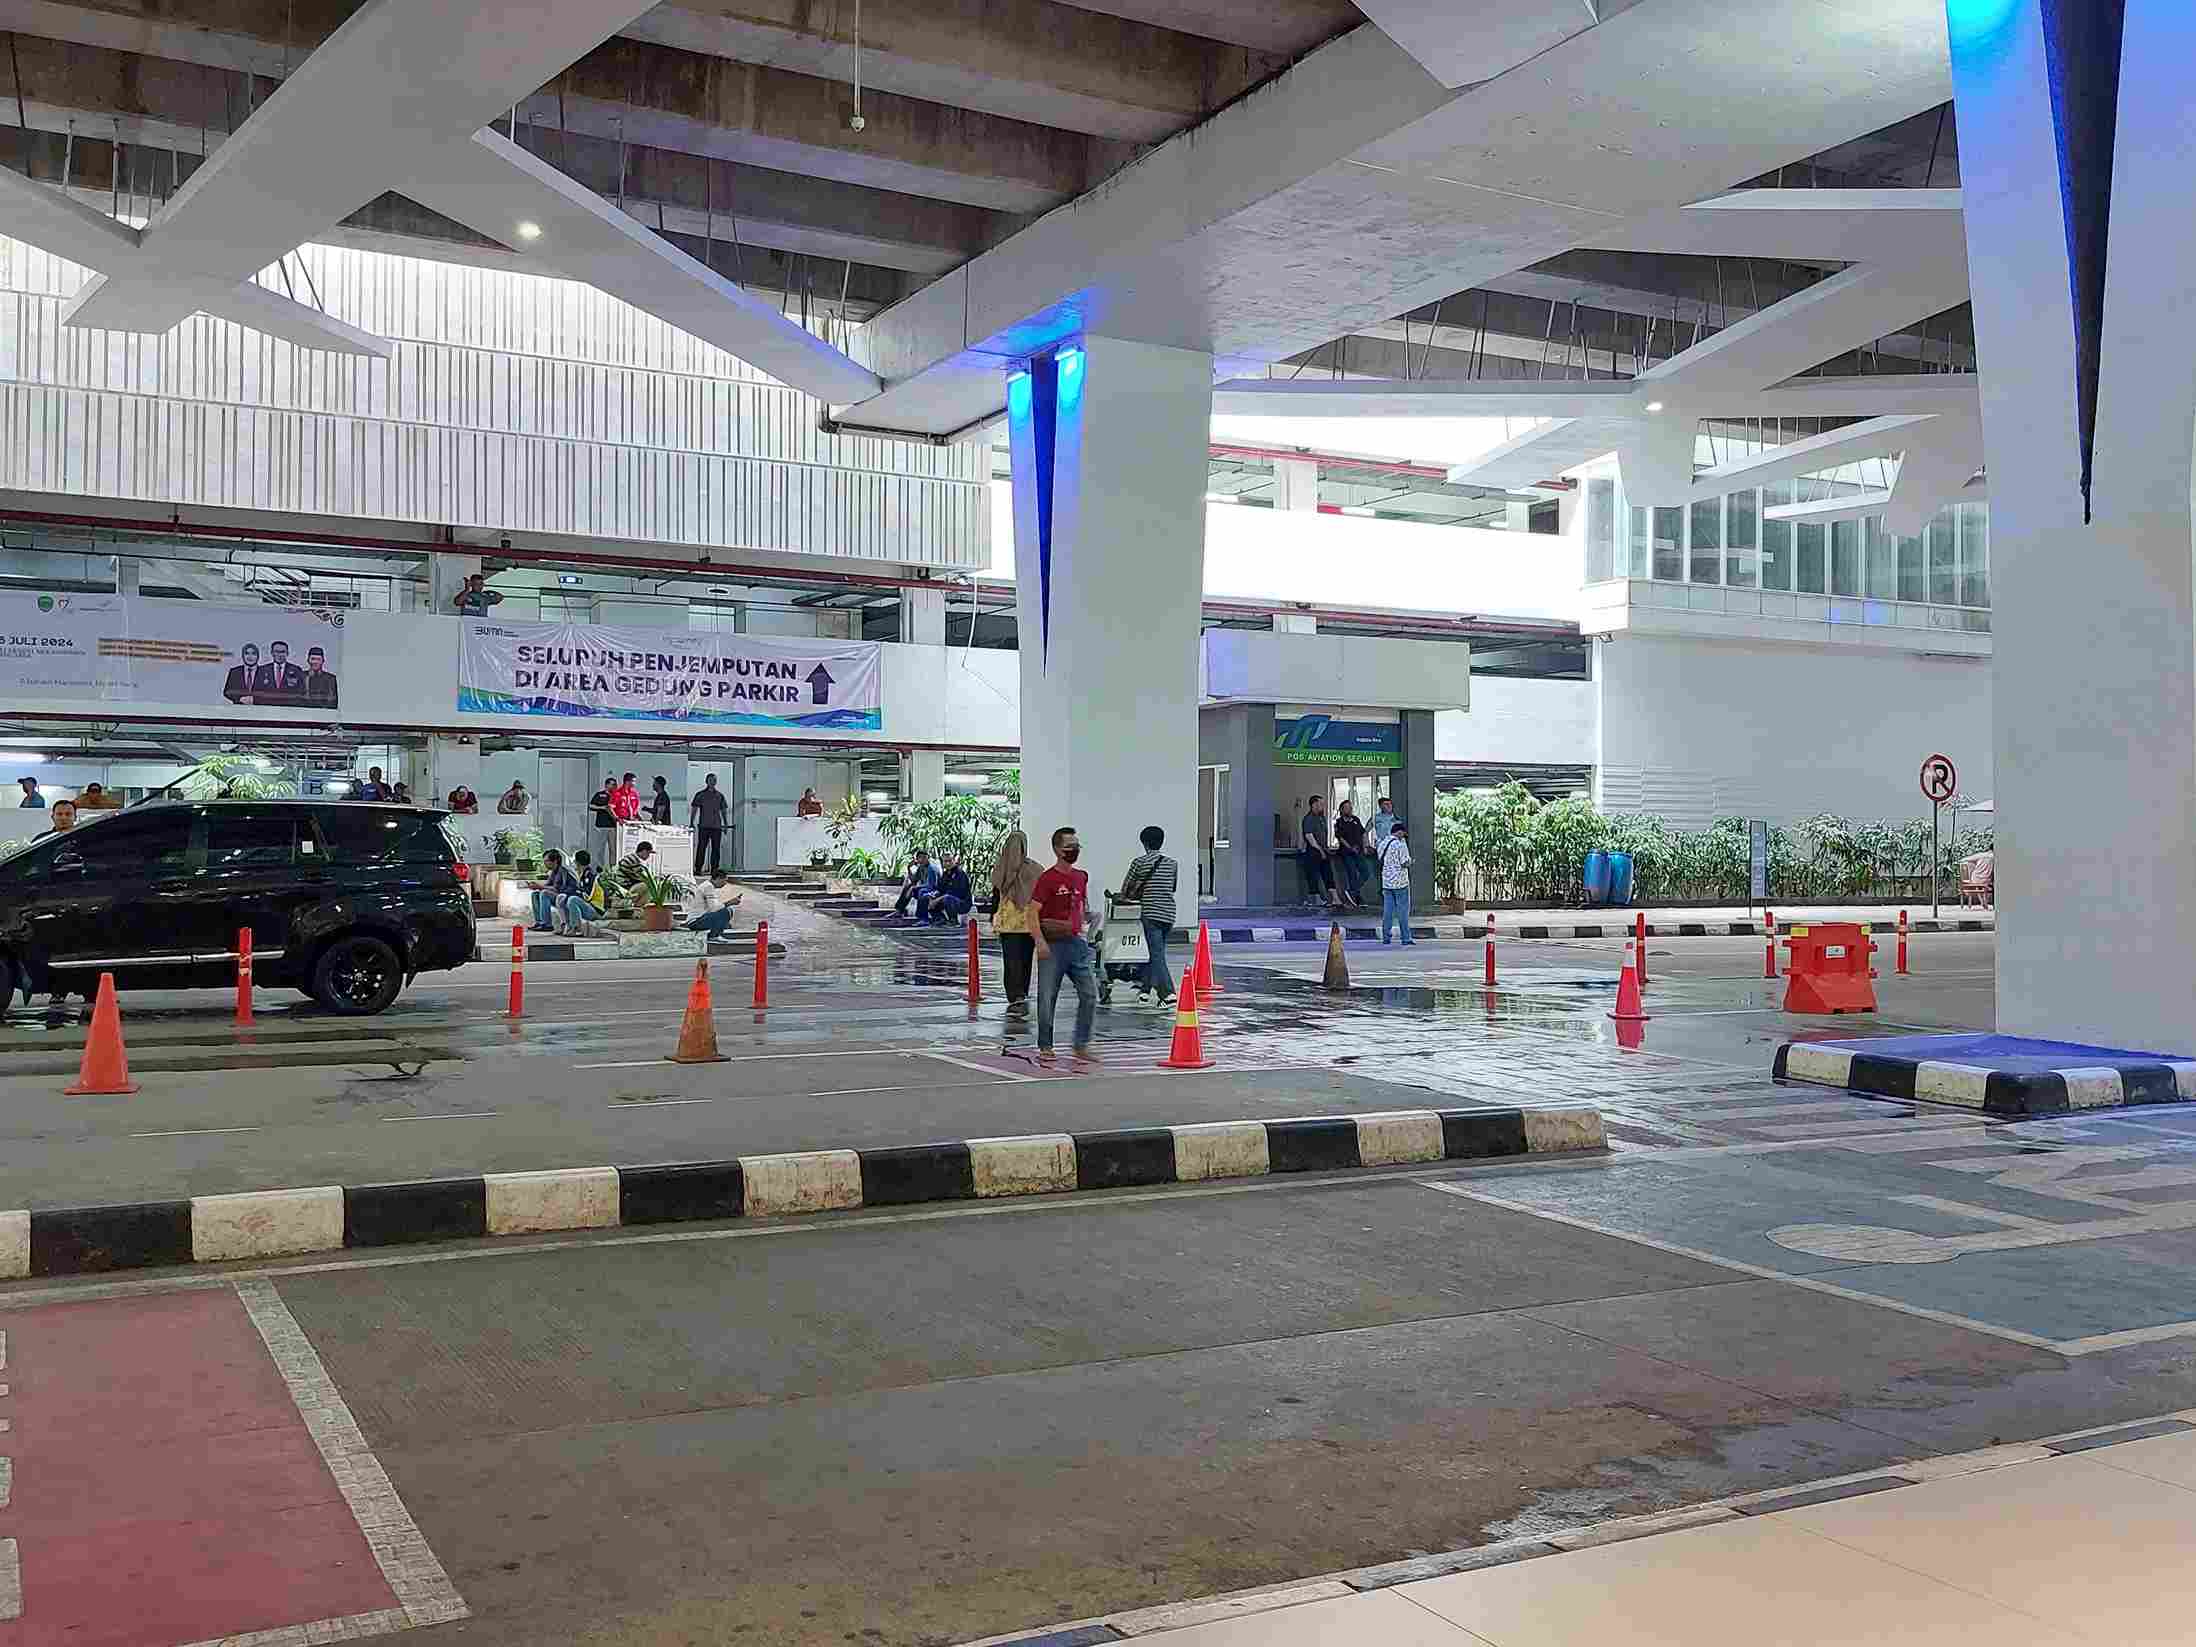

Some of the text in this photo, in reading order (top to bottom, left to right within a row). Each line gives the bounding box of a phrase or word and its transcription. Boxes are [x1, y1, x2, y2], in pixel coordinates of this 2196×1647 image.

[9, 636, 37, 646] JULI
[40, 638, 73, 648] 2024
[518, 645, 798, 680] SELURUH PENJEMPUTAN
[515, 669, 800, 703] DI AREA GEDUNG PARKIR
[1308, 752, 1344, 763] AVIATION
[1347, 754, 1386, 764] SECURITY
